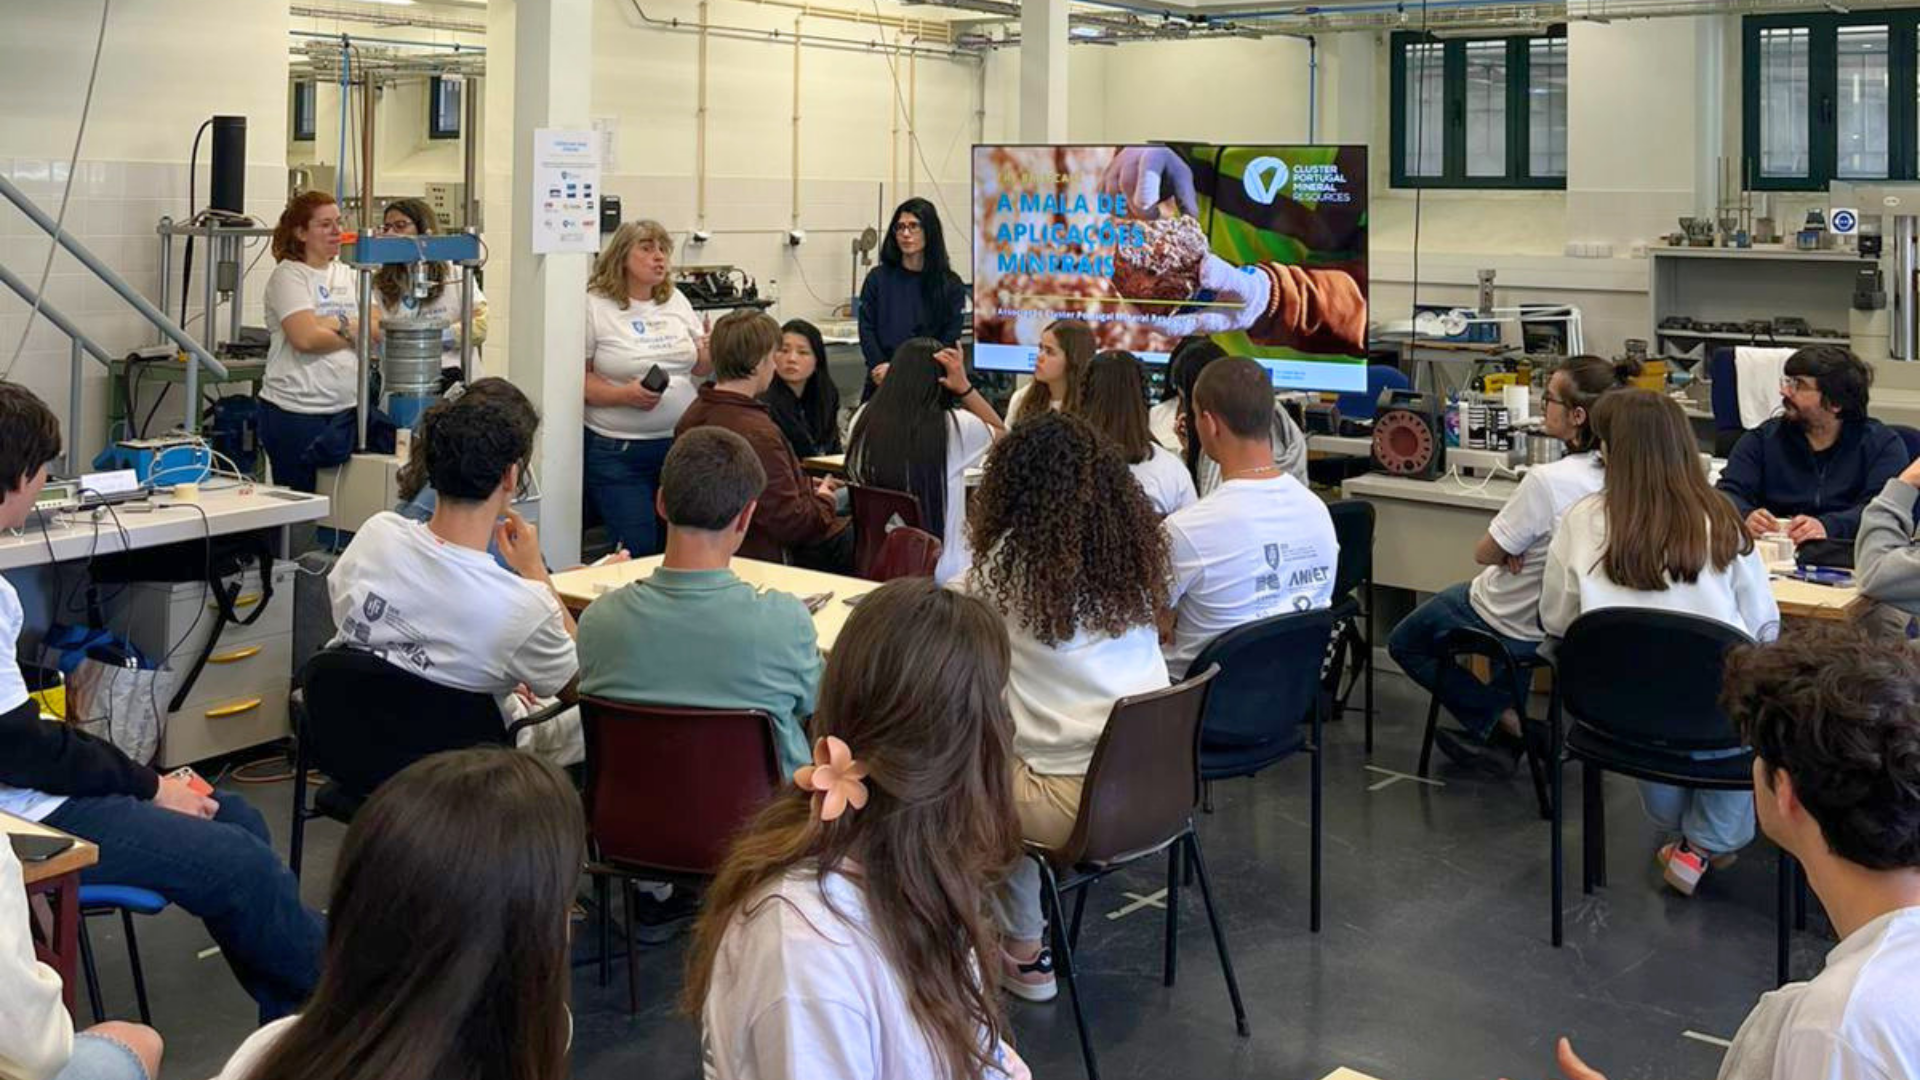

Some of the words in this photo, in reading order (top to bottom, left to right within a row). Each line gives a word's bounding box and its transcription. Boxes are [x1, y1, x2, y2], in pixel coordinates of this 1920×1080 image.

[1293, 164, 1338, 174] CLUSTER
[1293, 173, 1347, 183] PORTUGAL
[1293, 183, 1337, 192] MINERAL
[1293, 192, 1351, 202] RESOURCES
[997, 192, 1012, 213] A
[1019, 193, 1089, 215] MALA
[1097, 193, 1128, 218] DE
[997, 218, 1145, 252] APLICAÇÕES
[997, 252, 1115, 278] MINERAIS
